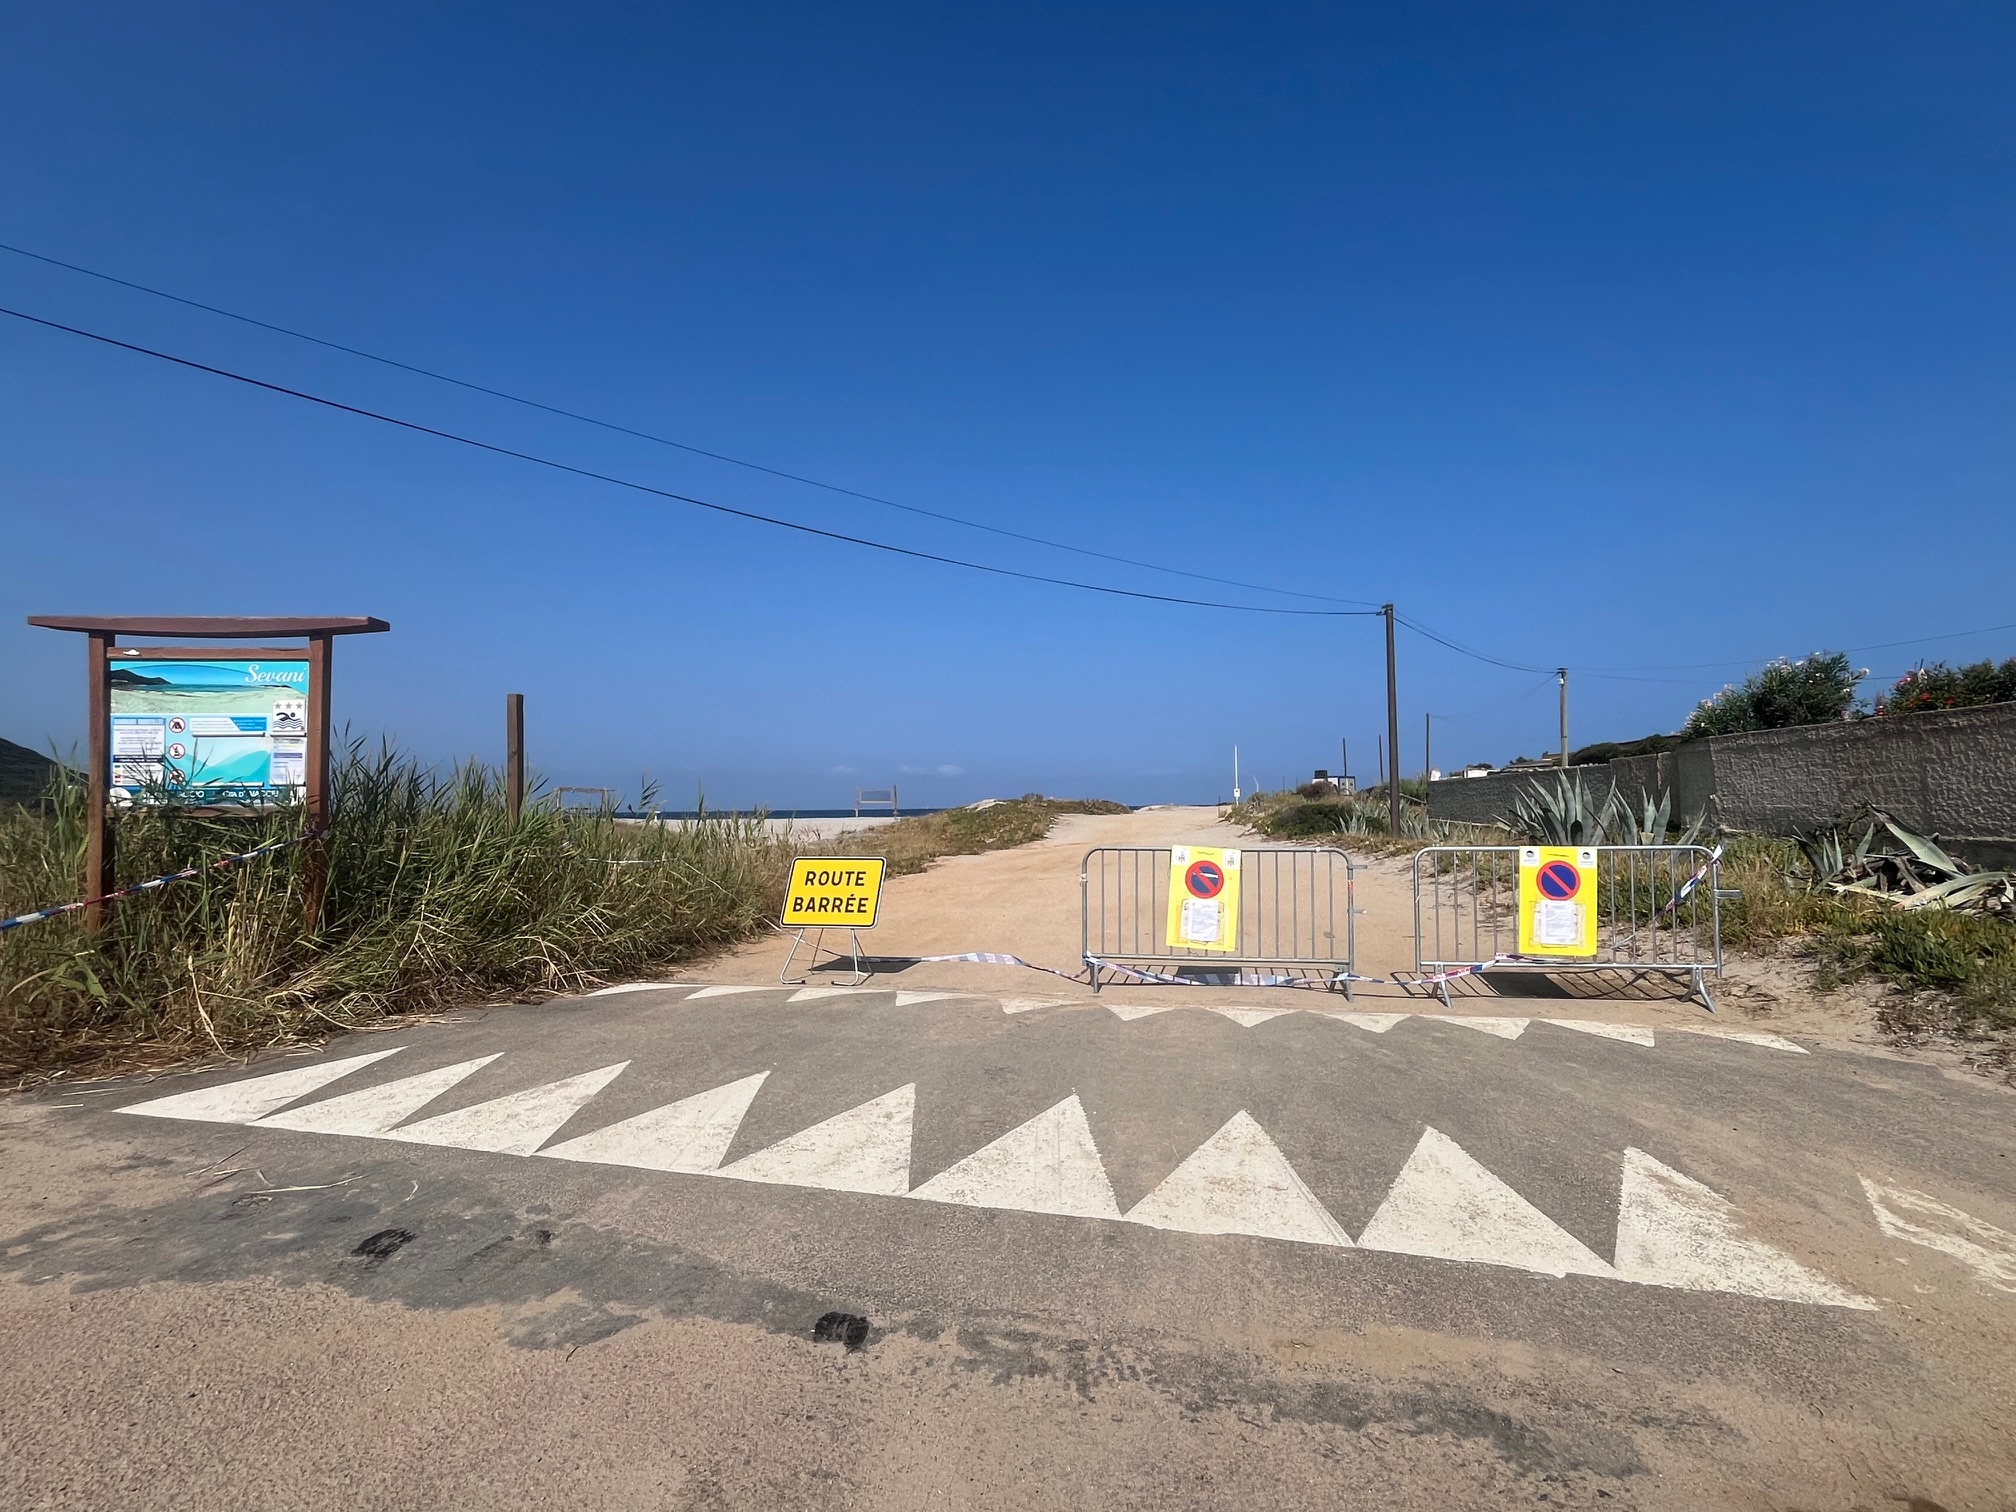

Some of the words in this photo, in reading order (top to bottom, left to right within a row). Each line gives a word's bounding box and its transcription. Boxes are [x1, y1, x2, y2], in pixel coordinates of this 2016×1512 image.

[245, 664, 306, 682] Sevani
[805, 871, 866, 886] ROUTE
[793, 894, 869, 913] BARRÉE
